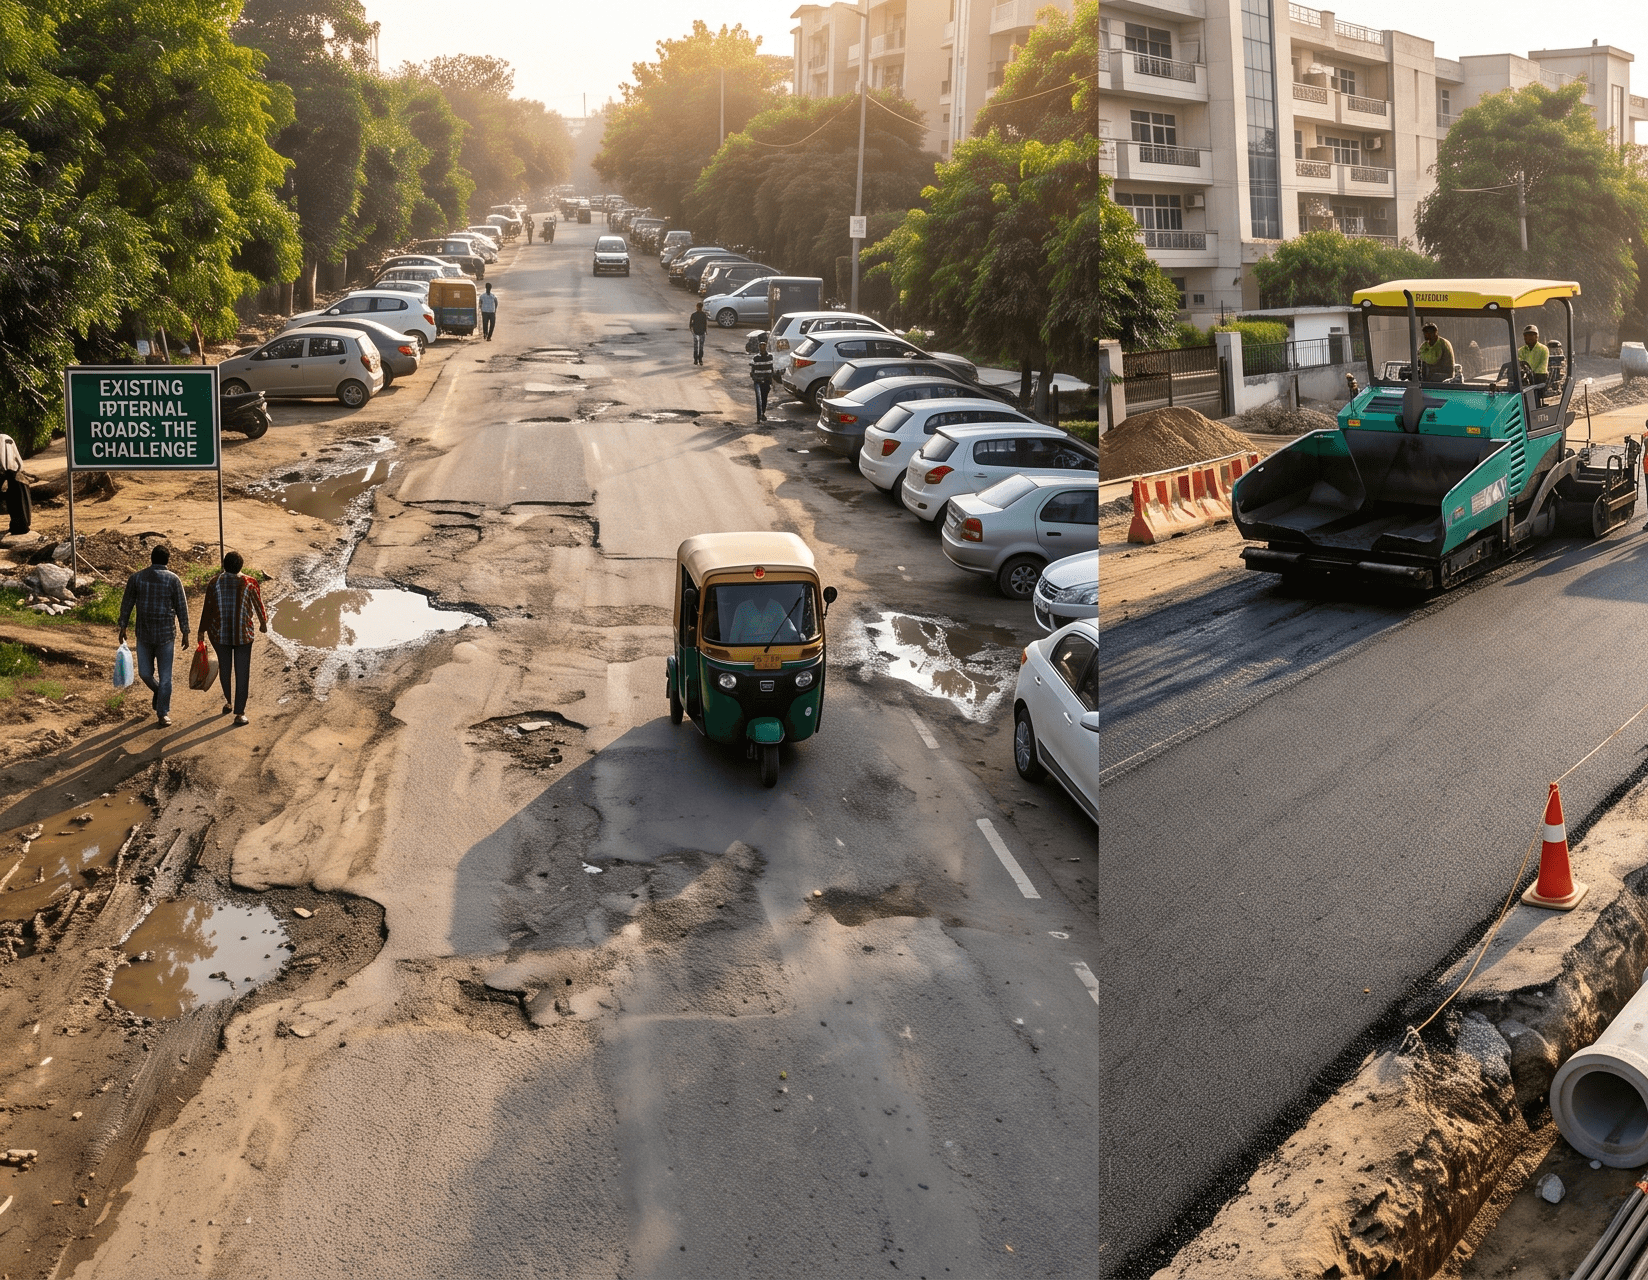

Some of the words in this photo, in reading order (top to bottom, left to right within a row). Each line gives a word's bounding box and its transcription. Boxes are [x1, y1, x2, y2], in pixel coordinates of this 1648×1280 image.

[100, 379, 184, 396] EXISTING
[90, 421, 156, 438] ROADS:
[161, 421, 198, 438] THE
[92, 441, 198, 458] CHALLENGE
